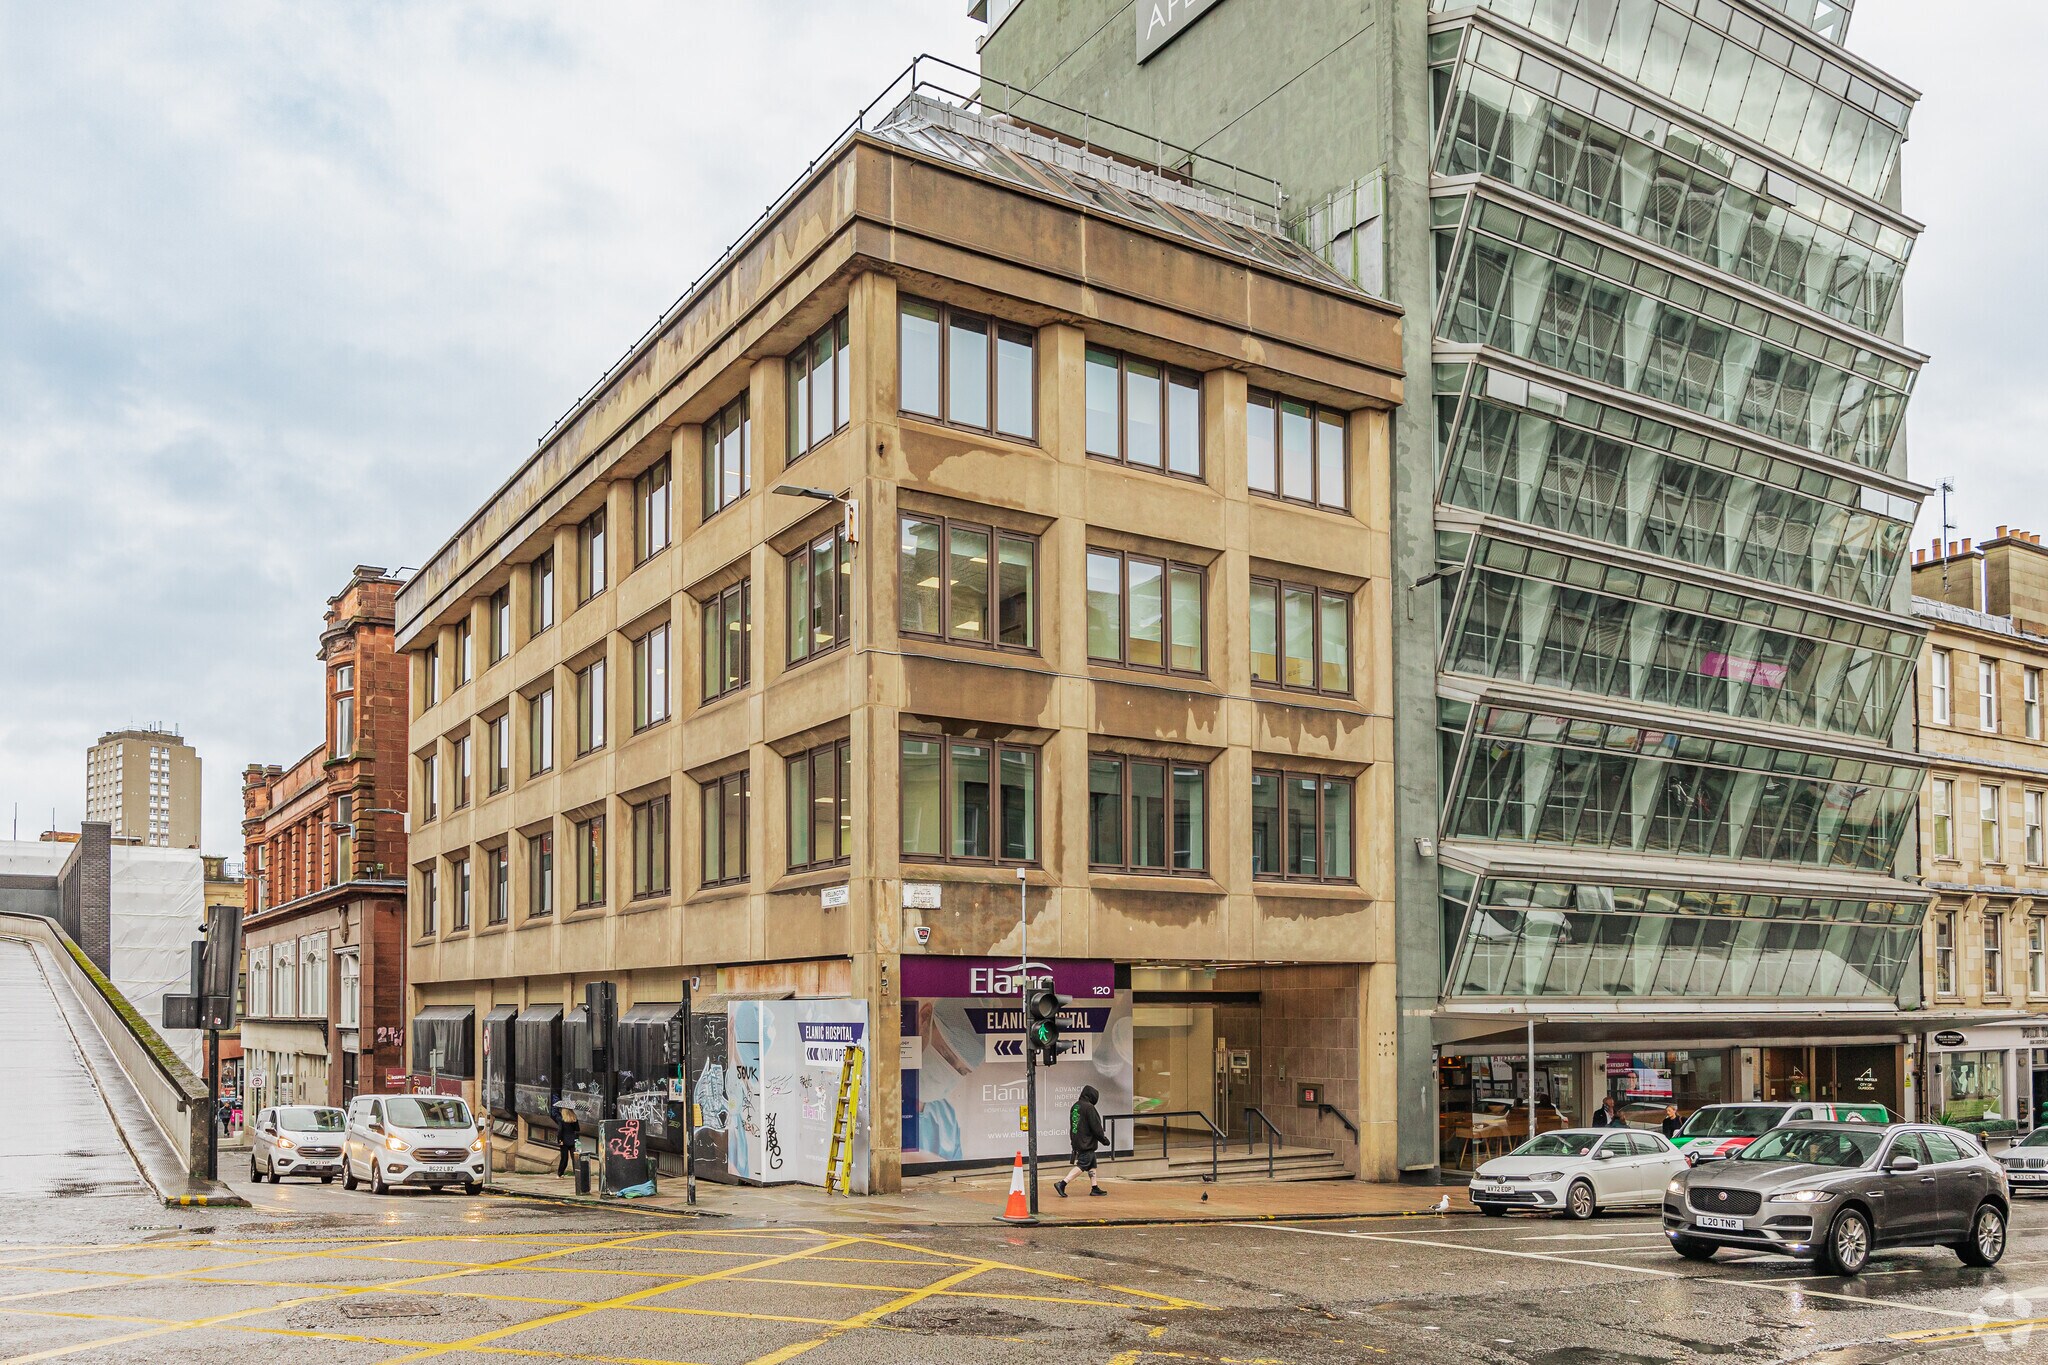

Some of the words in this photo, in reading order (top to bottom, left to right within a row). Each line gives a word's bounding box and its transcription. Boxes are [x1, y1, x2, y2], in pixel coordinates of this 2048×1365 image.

[1146, 0, 1196, 40] AP
[824, 889, 846, 898] WELLINGTON
[1092, 986, 1111, 995] 120
[805, 1025, 825, 1039] ELANIC
[825, 1026, 854, 1041] HOSPITAL
[820, 1047, 833, 1061] NOW
[835, 1049, 846, 1061] OPE
[982, 1084, 1028, 1101] Elani
[1702, 1217, 1719, 1227] L20
[1720, 1219, 1737, 1229] TNR
